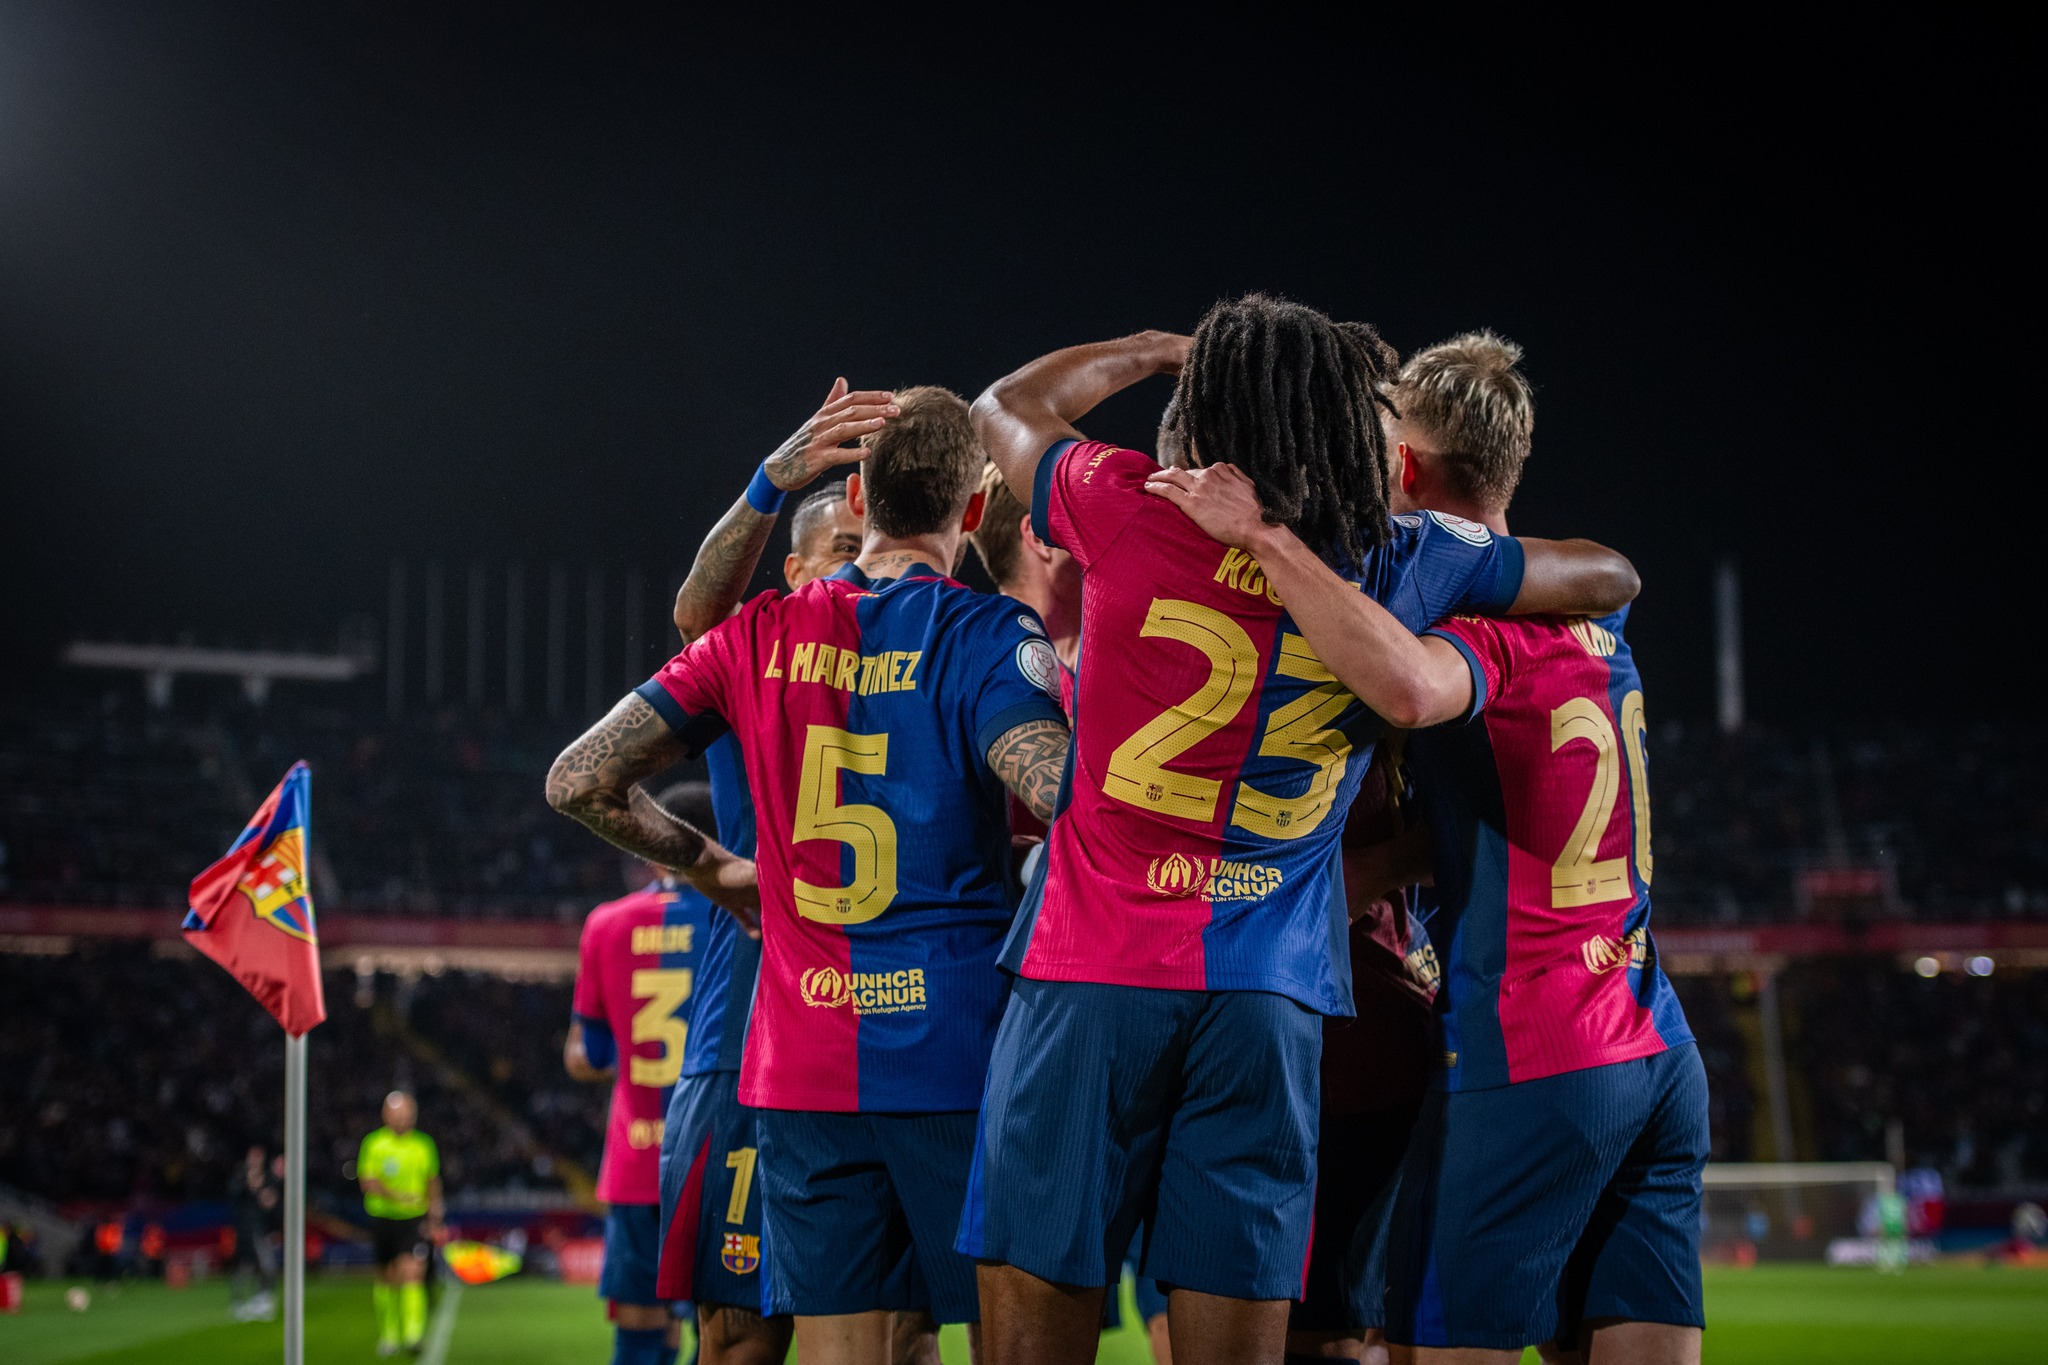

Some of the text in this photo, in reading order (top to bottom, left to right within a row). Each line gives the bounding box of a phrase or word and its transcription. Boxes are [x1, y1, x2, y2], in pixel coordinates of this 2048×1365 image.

[789, 641, 923, 697] MARTINEZ
[1102, 597, 1354, 840] 23
[791, 724, 899, 925] 5
[1210, 858, 1283, 883] UNHCR
[844, 968, 925, 990] UNHCR
[850, 986, 926, 1007] ACNUR
[630, 967, 693, 1088] 3
[872, 1005, 900, 1015] Refugee
[900, 1003, 927, 1012] Agency
